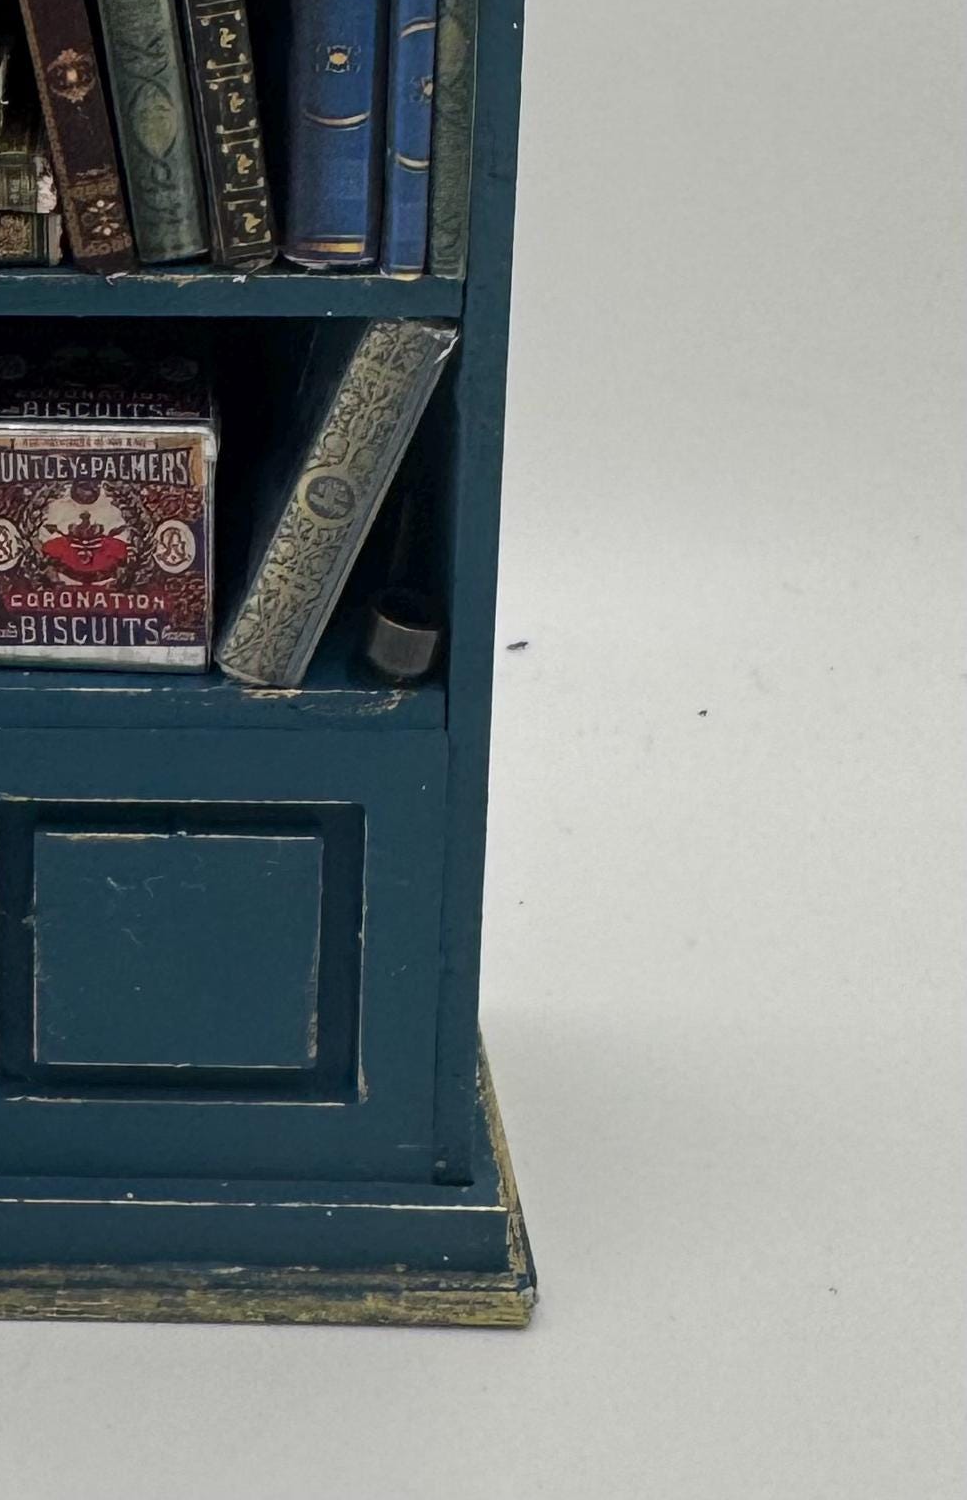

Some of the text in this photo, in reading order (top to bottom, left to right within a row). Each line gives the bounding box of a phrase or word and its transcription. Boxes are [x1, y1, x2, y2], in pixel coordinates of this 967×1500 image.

[23, 401, 163, 418] BISCUITS
[91, 450, 188, 485] PALMERS
[11, 592, 165, 610] CORONATION
[20, 615, 160, 645] BISCUITS
